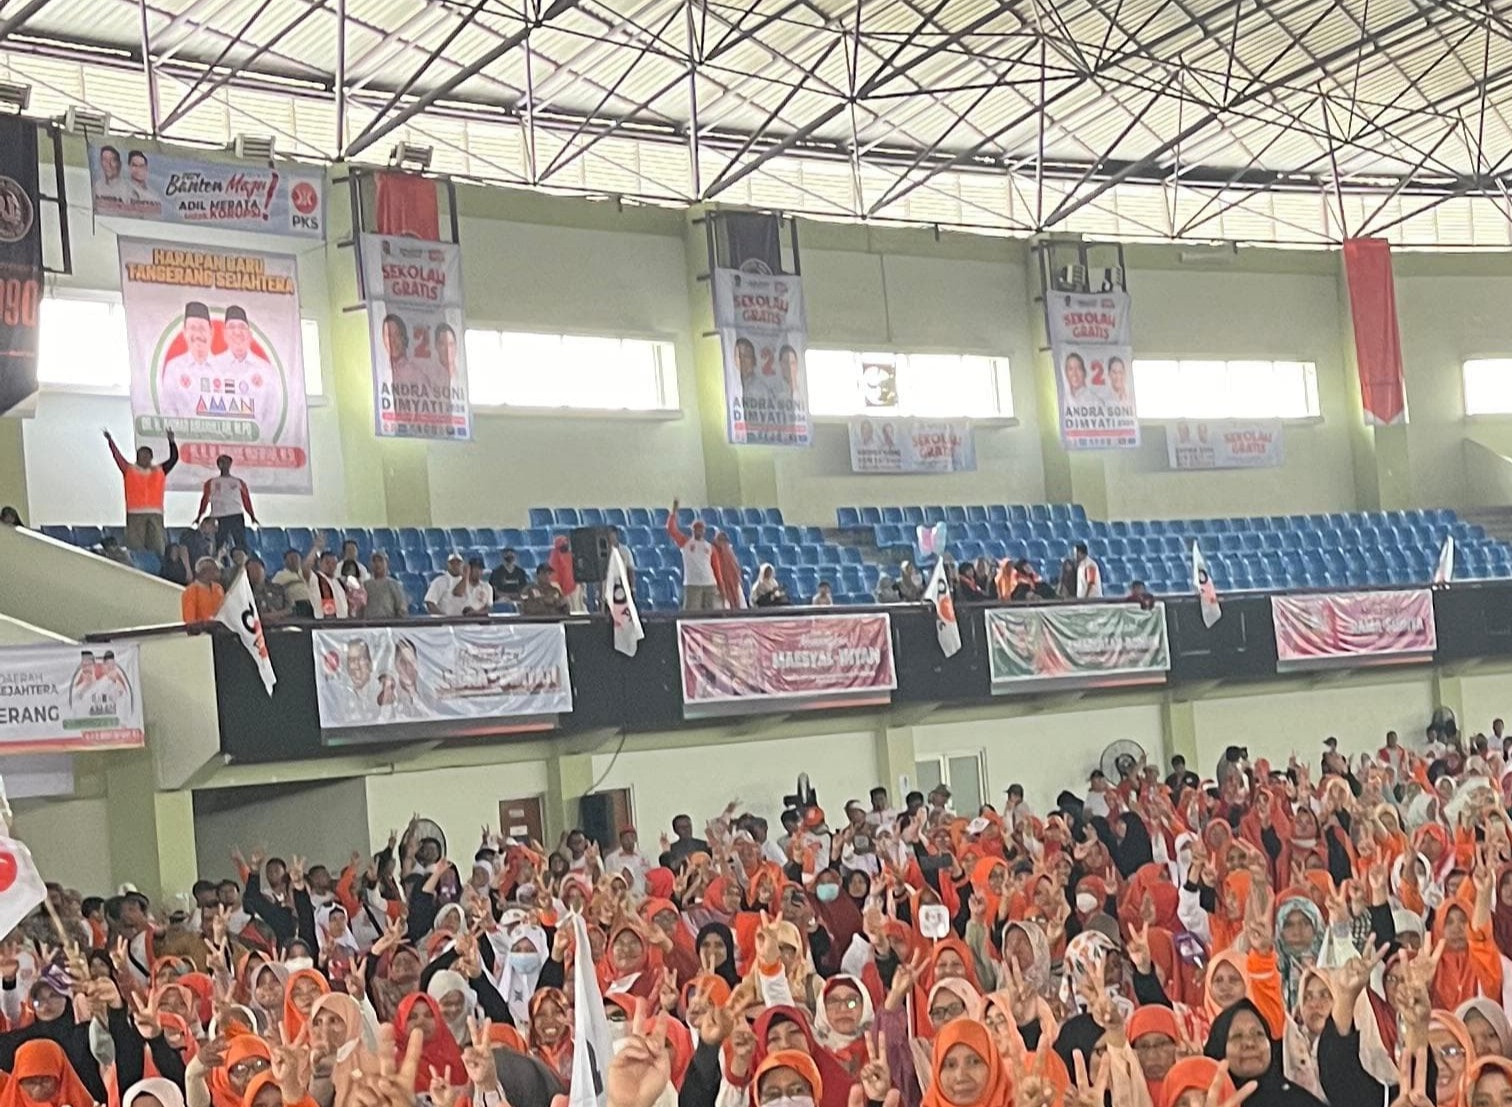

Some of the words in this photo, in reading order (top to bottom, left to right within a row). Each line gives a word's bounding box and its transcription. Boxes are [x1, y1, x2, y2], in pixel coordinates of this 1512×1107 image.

[165, 174, 222, 197] Banten
[178, 200, 206, 211] ADIL
[292, 214, 319, 230] PKS
[152, 248, 224, 271] HARAPAN
[126, 262, 214, 286] TANGERANG
[215, 269, 295, 295] SEJAHTERA
[382, 262, 446, 287] SEKOLAH
[391, 279, 438, 300] GRATIS
[413, 325, 432, 359] 2
[760, 346, 777, 377] 2
[1090, 359, 1106, 386] 2
[381, 381, 430, 399] ANDRA
[432, 384, 466, 402] SONI
[195, 395, 255, 415] AMAN
[381, 396, 444, 414] DIMYATI
[733, 396, 776, 411] ANDRA
[1065, 405, 1105, 418] ANDRA
[1106, 405, 1135, 418] SONI
[1065, 417, 1116, 430] DIMYATI
[0, 704, 60, 725] ERANG
